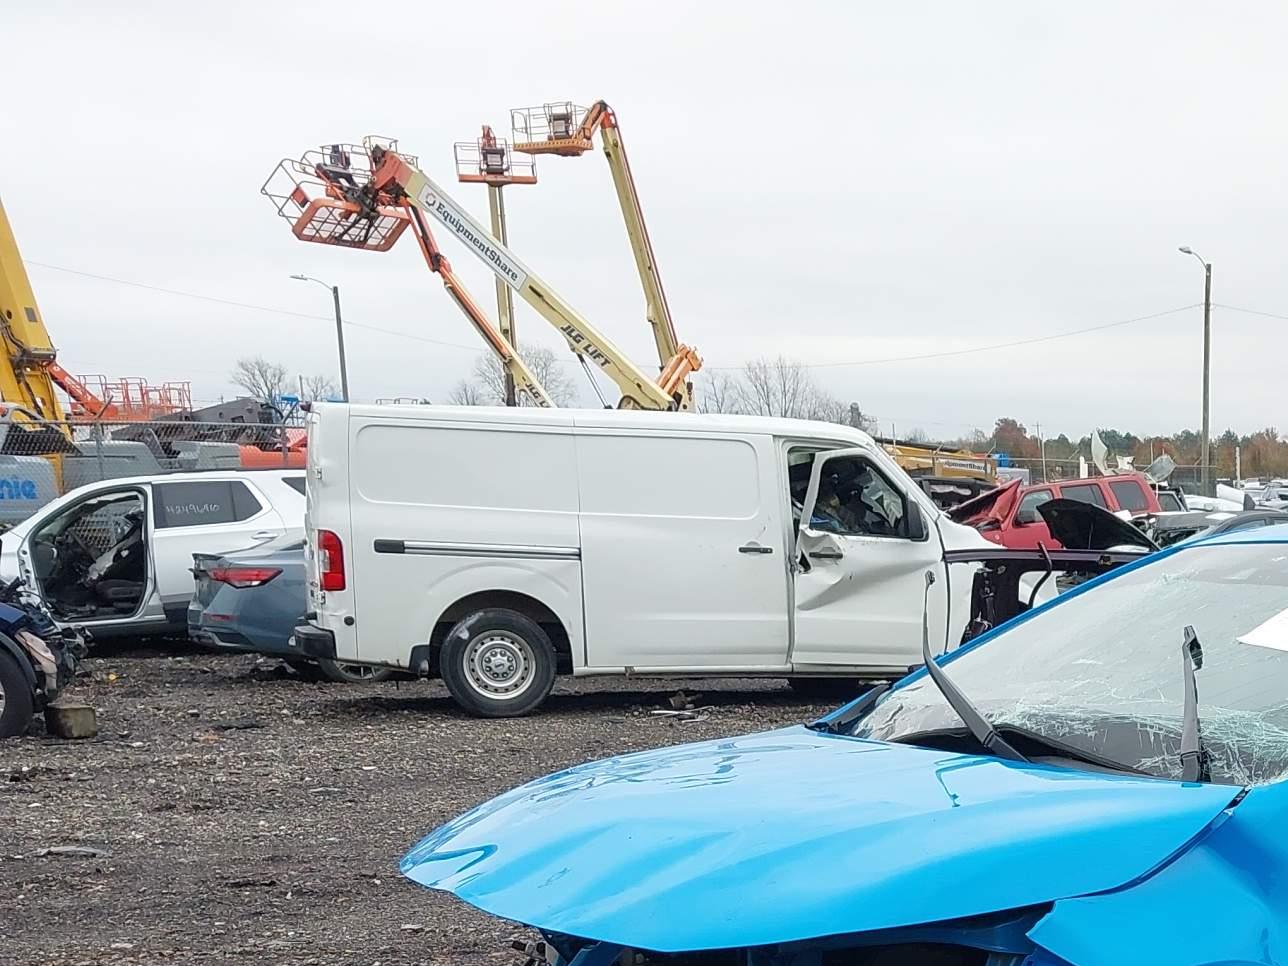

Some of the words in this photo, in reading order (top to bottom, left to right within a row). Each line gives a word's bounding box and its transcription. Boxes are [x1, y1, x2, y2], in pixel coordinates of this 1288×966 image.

[436, 202, 519, 282] EquipmentShare
[560, 324, 584, 344] JLG
[583, 343, 611, 367] LIFT
